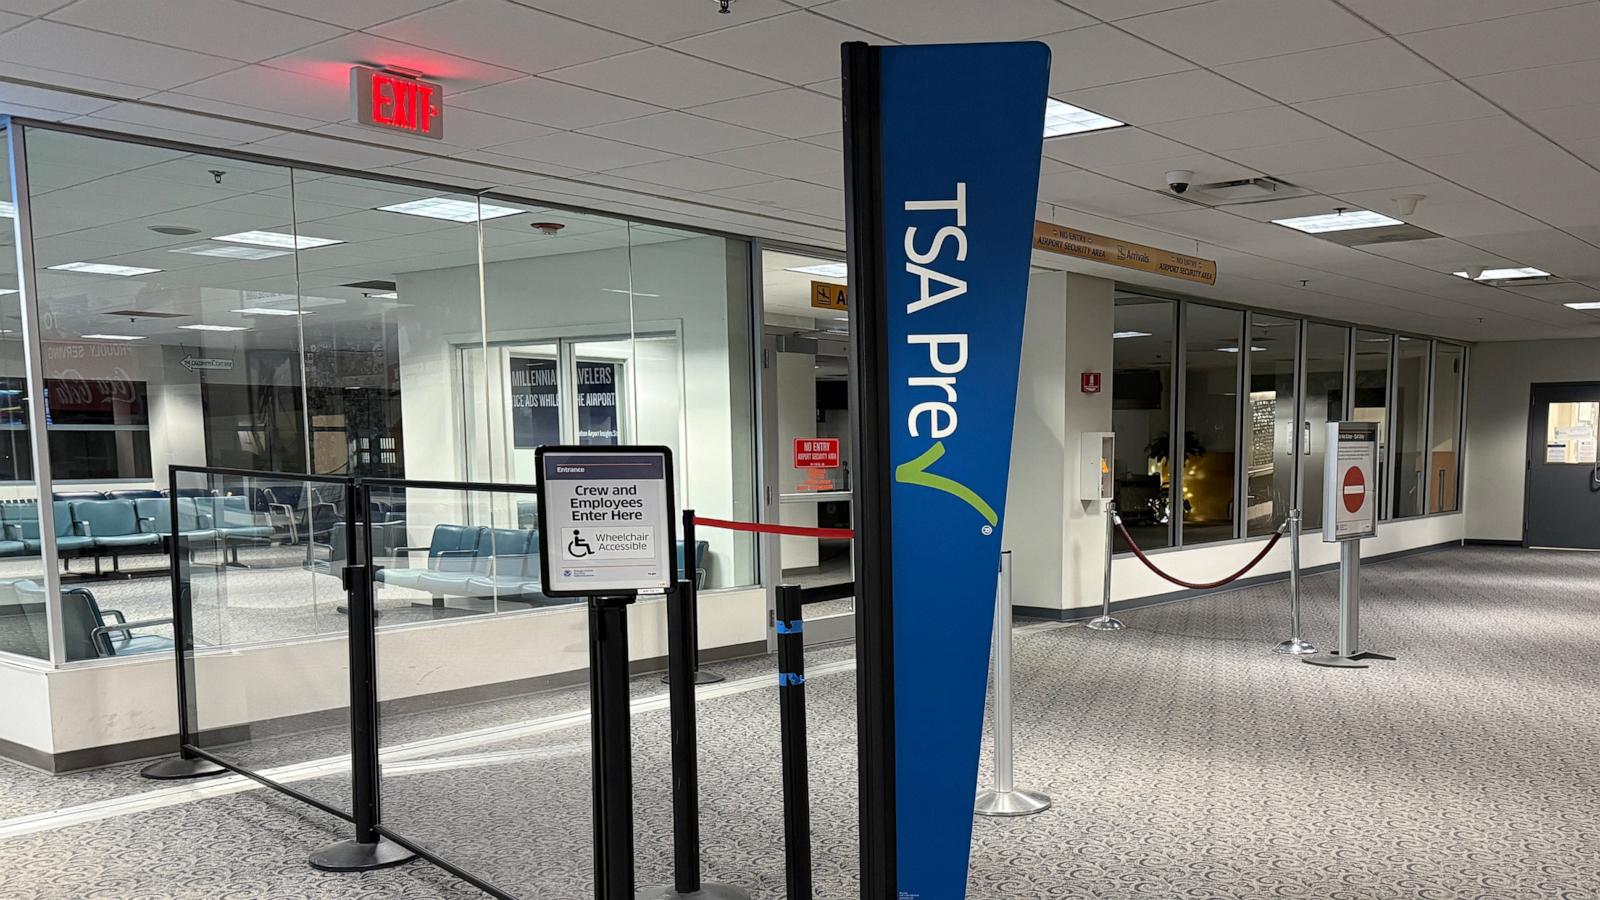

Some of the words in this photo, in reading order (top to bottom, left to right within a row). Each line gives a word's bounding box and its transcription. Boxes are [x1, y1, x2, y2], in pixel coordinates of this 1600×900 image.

[372, 74, 434, 133] EXIT
[1059, 230, 1068, 239] NO
[904, 182, 968, 315] TSA
[1038, 235, 1063, 249] AIRPORT
[1064, 242, 1091, 255] SECURITY
[1092, 248, 1106, 258] AREA
[1126, 250, 1150, 263] Arrivals
[1159, 263, 1180, 274] AIRPORT
[1179, 266, 1201, 278] SECURITY
[1201, 271, 1213, 280] AREA
[511, 369, 558, 387] MILLENNIA
[577, 366, 612, 385] VELERS
[907, 333, 969, 438] Pre
[525, 393, 539, 407] ADS
[586, 392, 616, 407] AIRPORT
[804, 442, 812, 451] NO
[813, 442, 830, 451] ENTRY
[575, 485, 609, 496] Crew
[612, 484, 637, 495] and
[570, 497, 643, 510] Employees
[572, 510, 608, 521] Enter
[611, 510, 643, 520] Here
[595, 533, 649, 542] Wheelchair
[598, 542, 647, 551] Accessible
